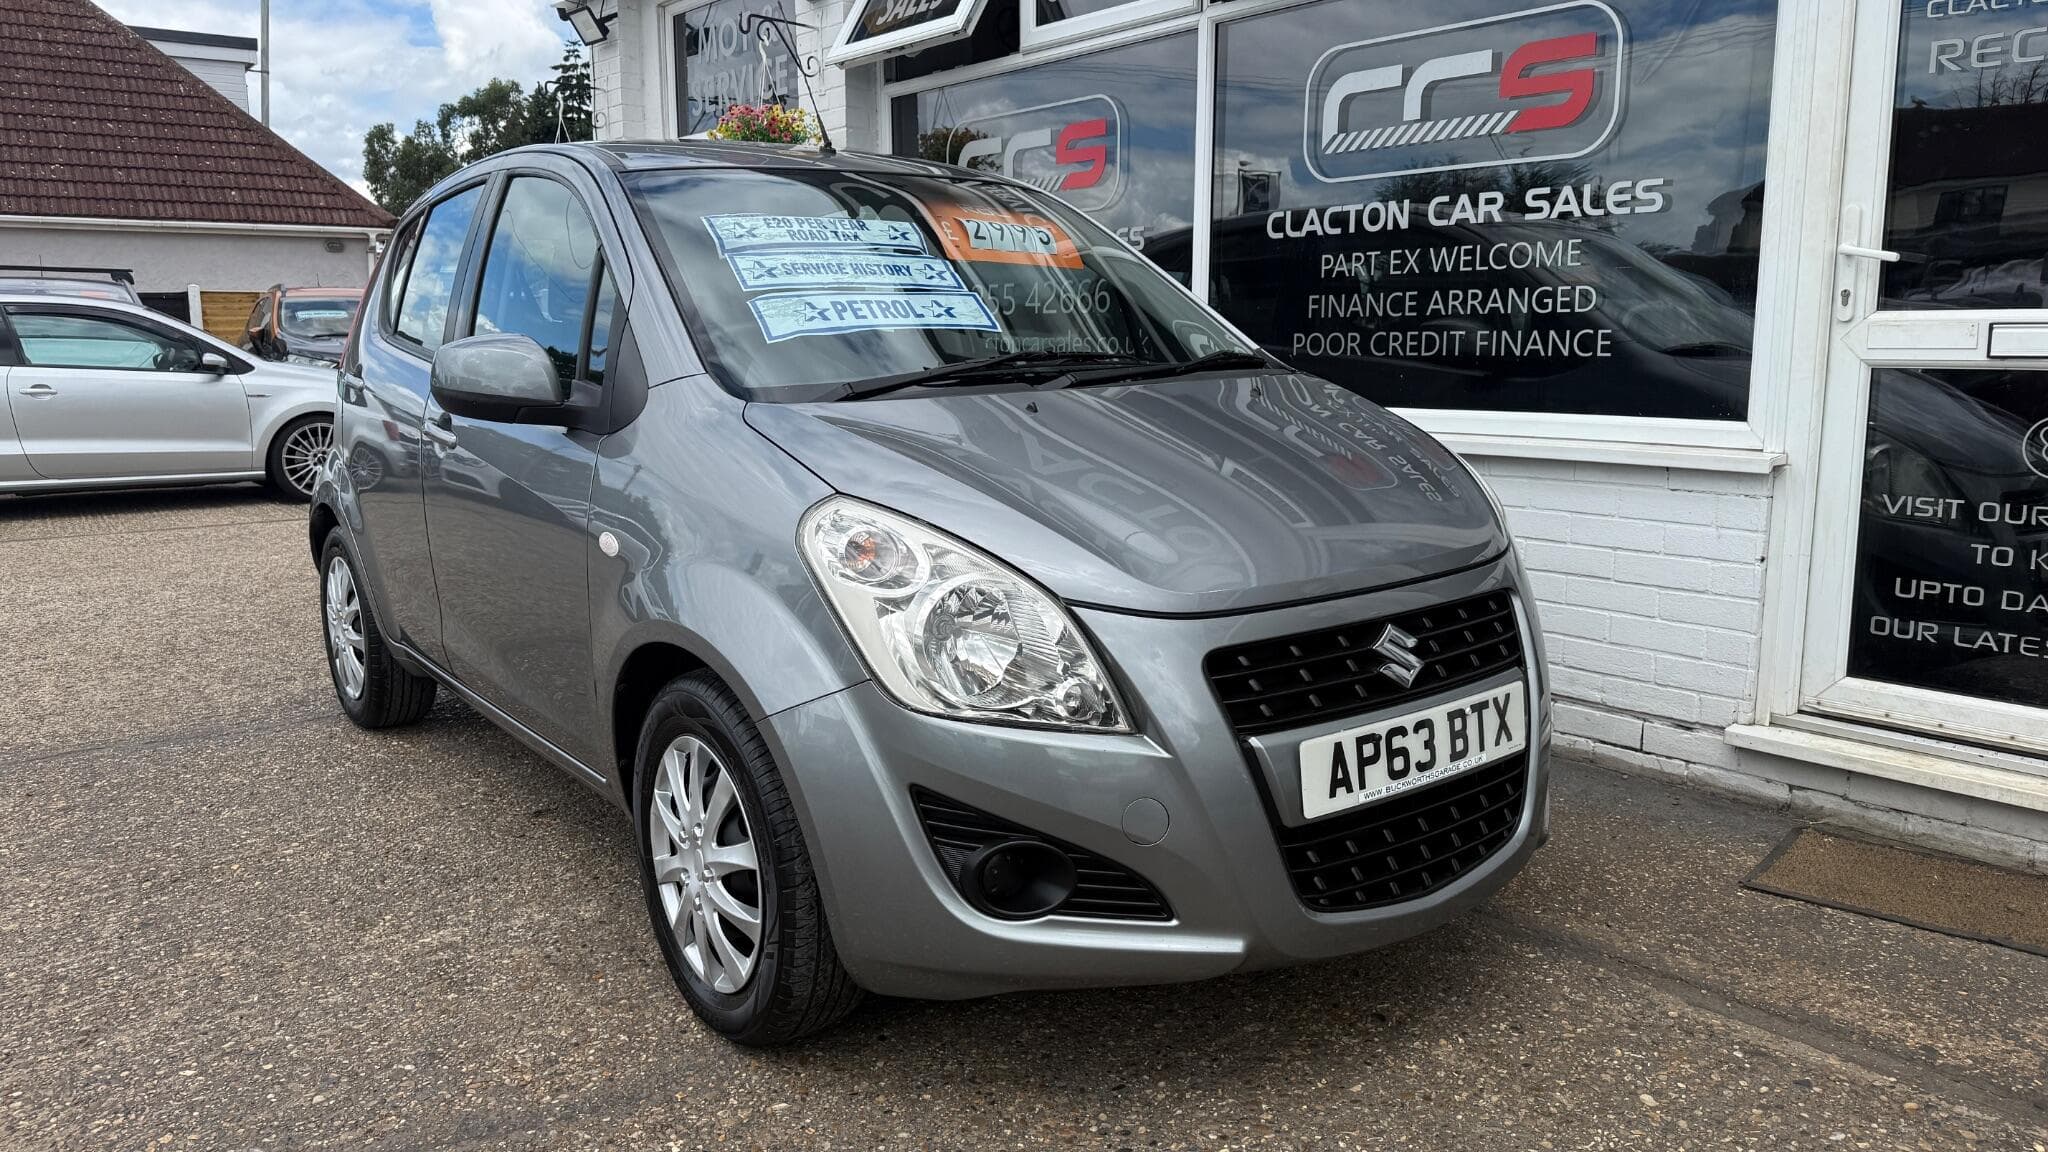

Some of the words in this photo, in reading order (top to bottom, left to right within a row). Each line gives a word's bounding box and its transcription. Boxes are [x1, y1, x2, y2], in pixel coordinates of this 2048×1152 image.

[875, 0, 943, 26] SAL
[1927, 0, 2048, 18] CLA
[1928, 26, 2048, 74] REC
[1266, 198, 1410, 239] CLACTON
[1428, 191, 1505, 227] CAR
[1525, 178, 1664, 220] SALES
[764, 216, 790, 230] £20
[794, 219, 829, 230] PER
[832, 220, 870, 232] YEAR
[790, 229, 831, 241] ROAD
[833, 230, 863, 242] TAX
[781, 262, 849, 276] SERVICE
[851, 262, 913, 277] HISTORY
[1321, 251, 1381, 279] PART
[1389, 248, 1421, 275] EX
[1430, 239, 1582, 273] WELCOME
[830, 300, 925, 321] PETROL
[1308, 291, 1418, 318] FINANCE
[1426, 285, 1597, 315] ARRANGED
[1293, 332, 1361, 357] POOR
[1369, 330, 1465, 357] CREDIT
[1475, 329, 1612, 357] FINANCE
[1882, 493, 1965, 520] VISIT
[1978, 501, 2048, 526] OUR
[1970, 543, 2014, 567] TO
[1895, 577, 1985, 607] UPTO
[2000, 590, 2048, 613] DA
[1869, 615, 1939, 644] OUR
[1953, 626, 2048, 659] LATE
[1328, 717, 1437, 799] AP63
[1447, 692, 1513, 762] BTX
